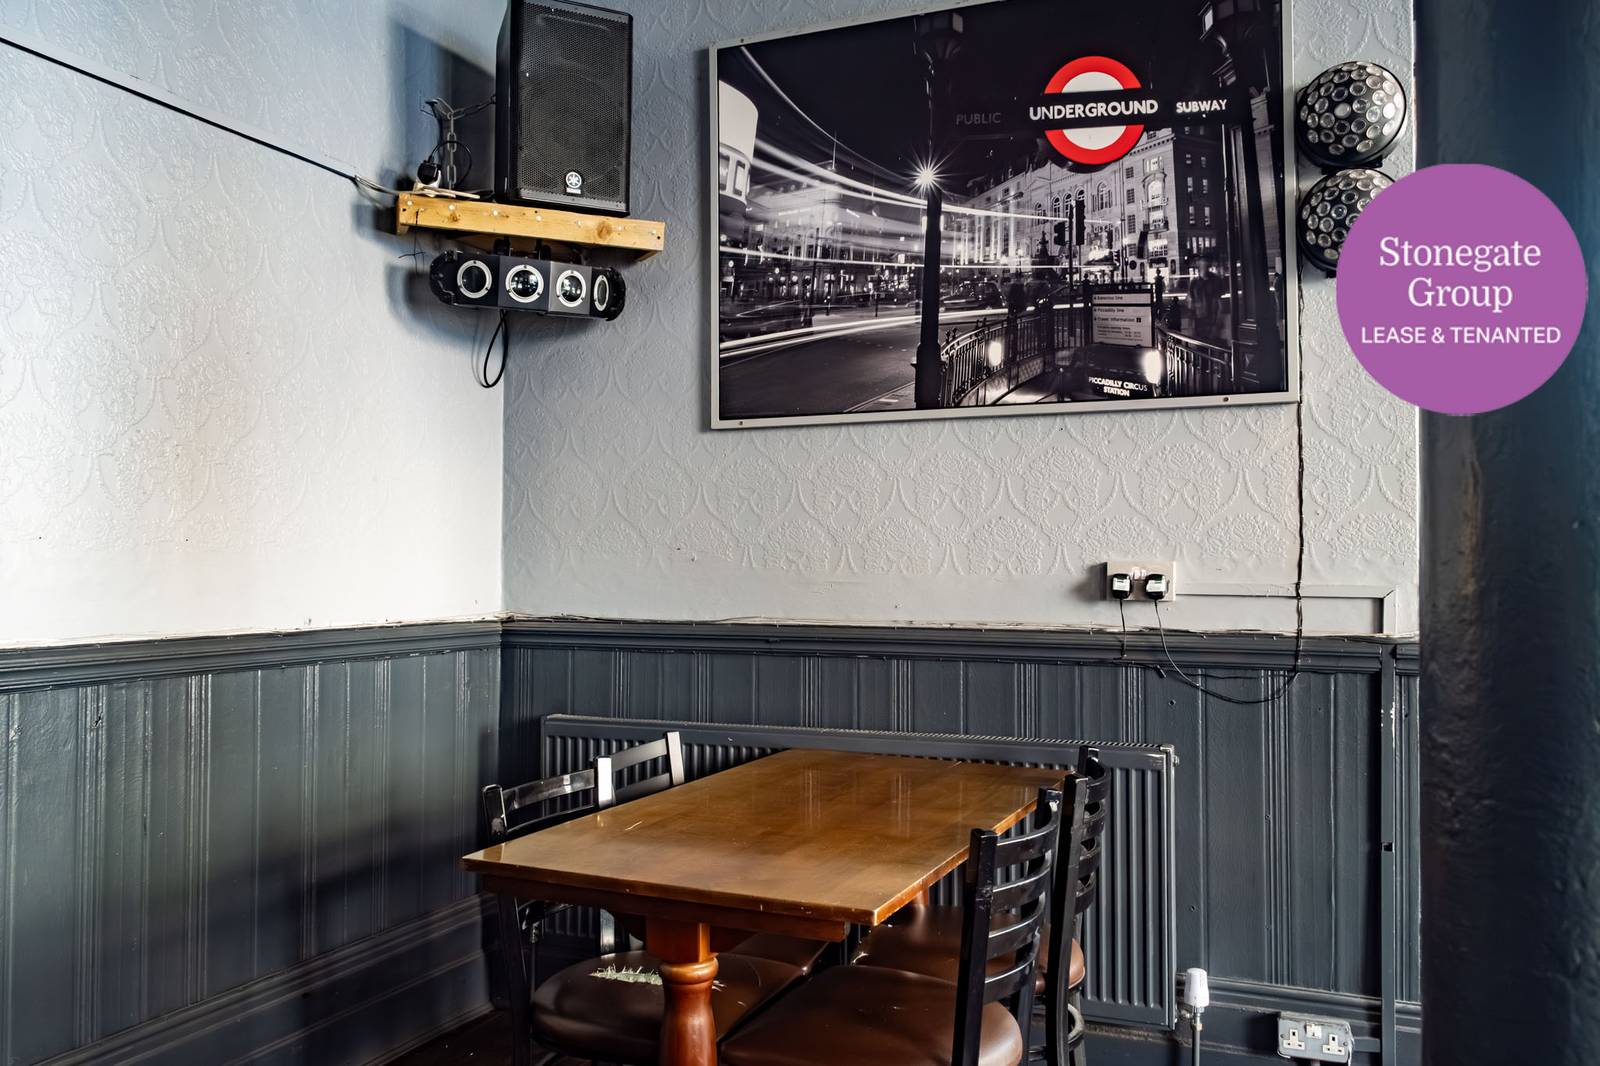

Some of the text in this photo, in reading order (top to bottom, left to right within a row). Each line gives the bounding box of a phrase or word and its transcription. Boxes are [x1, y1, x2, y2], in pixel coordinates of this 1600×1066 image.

[956, 98, 1227, 125] PUBLIC UNDERGROUND SUBWAY
[1088, 376, 1148, 392] PICCADILLY CIRCUS
[1103, 386, 1130, 397] STATION
